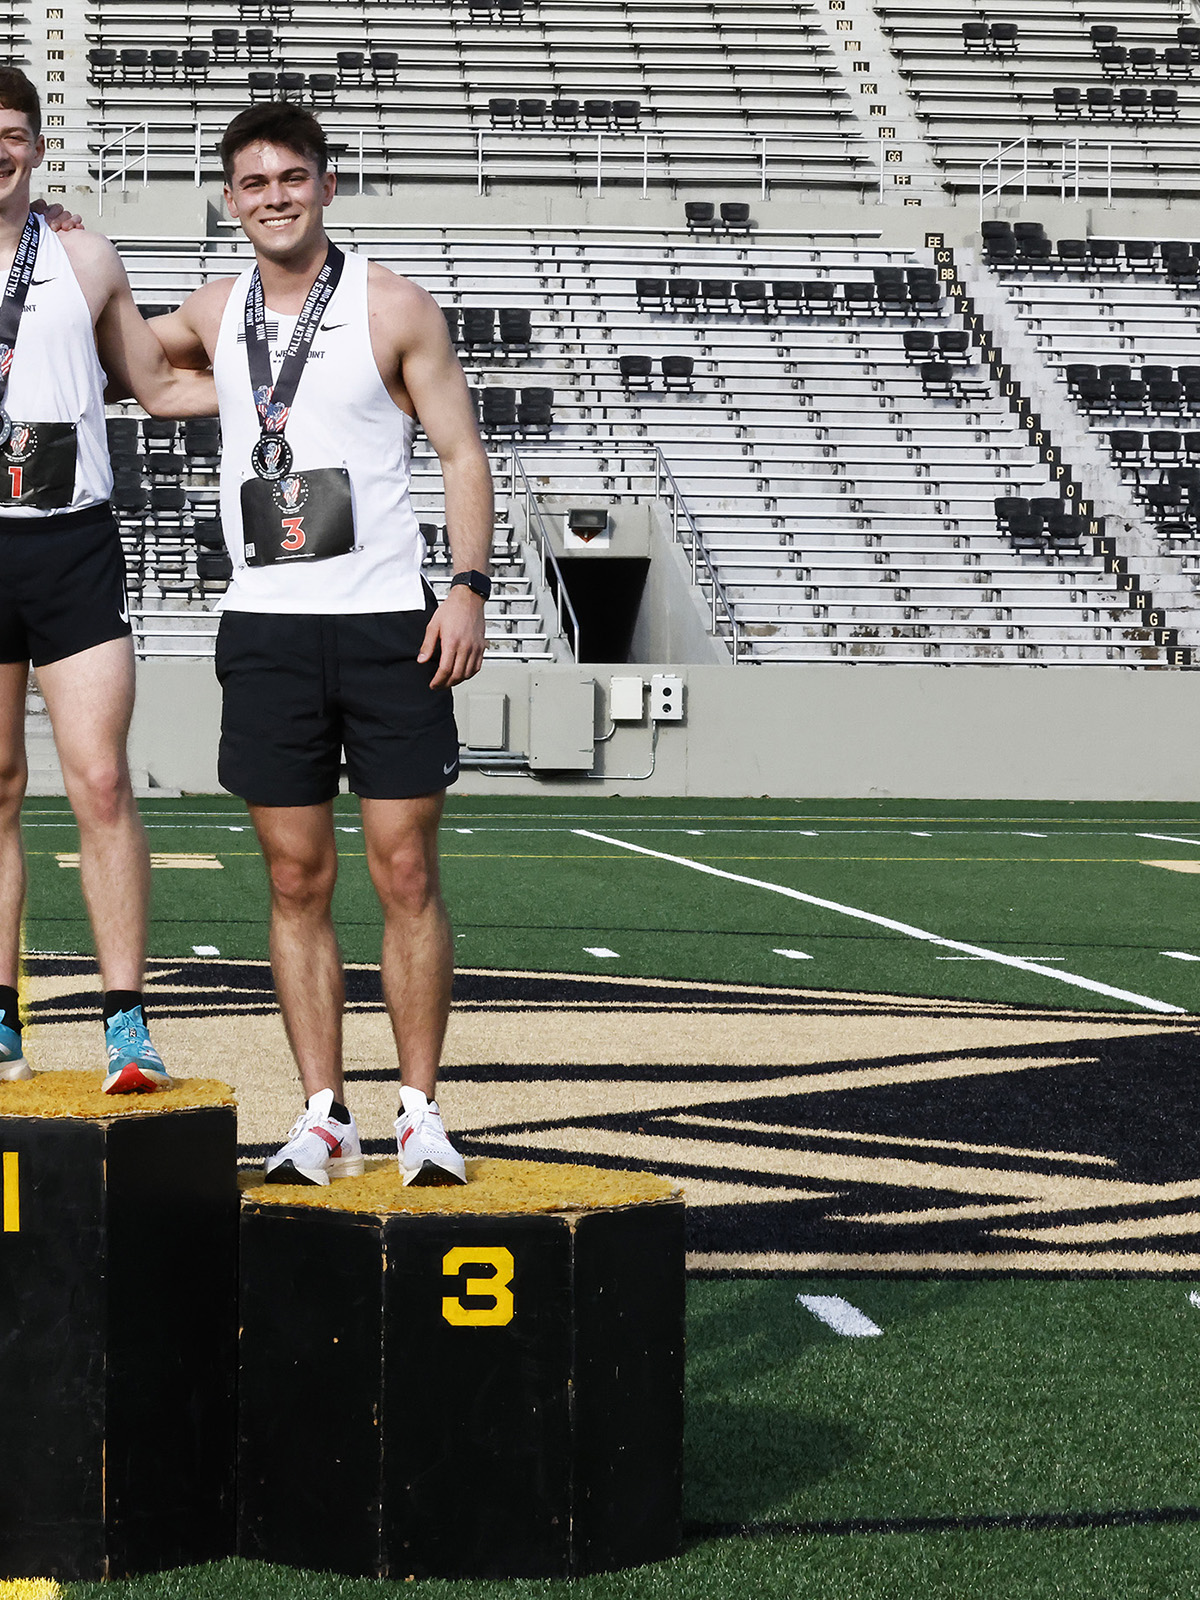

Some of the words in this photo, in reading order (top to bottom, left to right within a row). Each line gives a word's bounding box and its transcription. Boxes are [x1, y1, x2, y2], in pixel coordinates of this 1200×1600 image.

[855, 63, 867, 72] LL
[49, 72, 61, 81] KK
[863, 85, 875, 94] KK
[50, 94, 61, 104] JJ
[872, 107, 884, 116] JJ
[49, 117, 61, 126] HH
[881, 129, 893, 138] HH
[49, 139, 61, 149] GG
[888, 152, 900, 161] GG
[928, 237, 941, 247] EE
[5, 266, 22, 298] FALLEN
[15, 225, 33, 266] COMRADES
[26, 247, 37, 265] WEST
[937, 252, 950, 262] CC
[21, 264, 33, 285] ARMY
[941, 269, 954, 279] BB
[950, 285, 962, 295] AA
[254, 281, 264, 323] COMRADES
[961, 301, 968, 312] Z
[287, 324, 305, 357] FALLEN
[299, 281, 324, 325] COMRADES
[318, 264, 332, 282] RUN
[303, 321, 316, 344] ARMY
[310, 303, 325, 322] WEST
[320, 284, 334, 303] POINT
[246, 308, 254, 327] POINT
[970, 317, 977, 328] Y
[256, 324, 266, 341] RUN
[979, 334, 986, 345] X
[988, 351, 995, 362] W
[996, 367, 1004, 378] V
[1006, 384, 1013, 395] U
[1016, 400, 1023, 411] T
[1026, 417, 1033, 428] S
[1036, 433, 1043, 444] R
[1046, 450, 1054, 461] Q
[1056, 467, 1064, 479] P
[8, 465, 23, 499] 1
[1067, 485, 1074, 496] O
[1079, 503, 1086, 515] N
[1090, 521, 1098, 534] M
[280, 516, 306, 551] 3
[1101, 541, 1109, 553] L
[1112, 560, 1119, 572] K
[1125, 577, 1132, 590] J
[1137, 595, 1145, 608] H
[1150, 613, 1158, 626] G
[1162, 631, 1170, 644] F
[1175, 651, 1183, 664] E
[441, 1246, 515, 1327] 3
